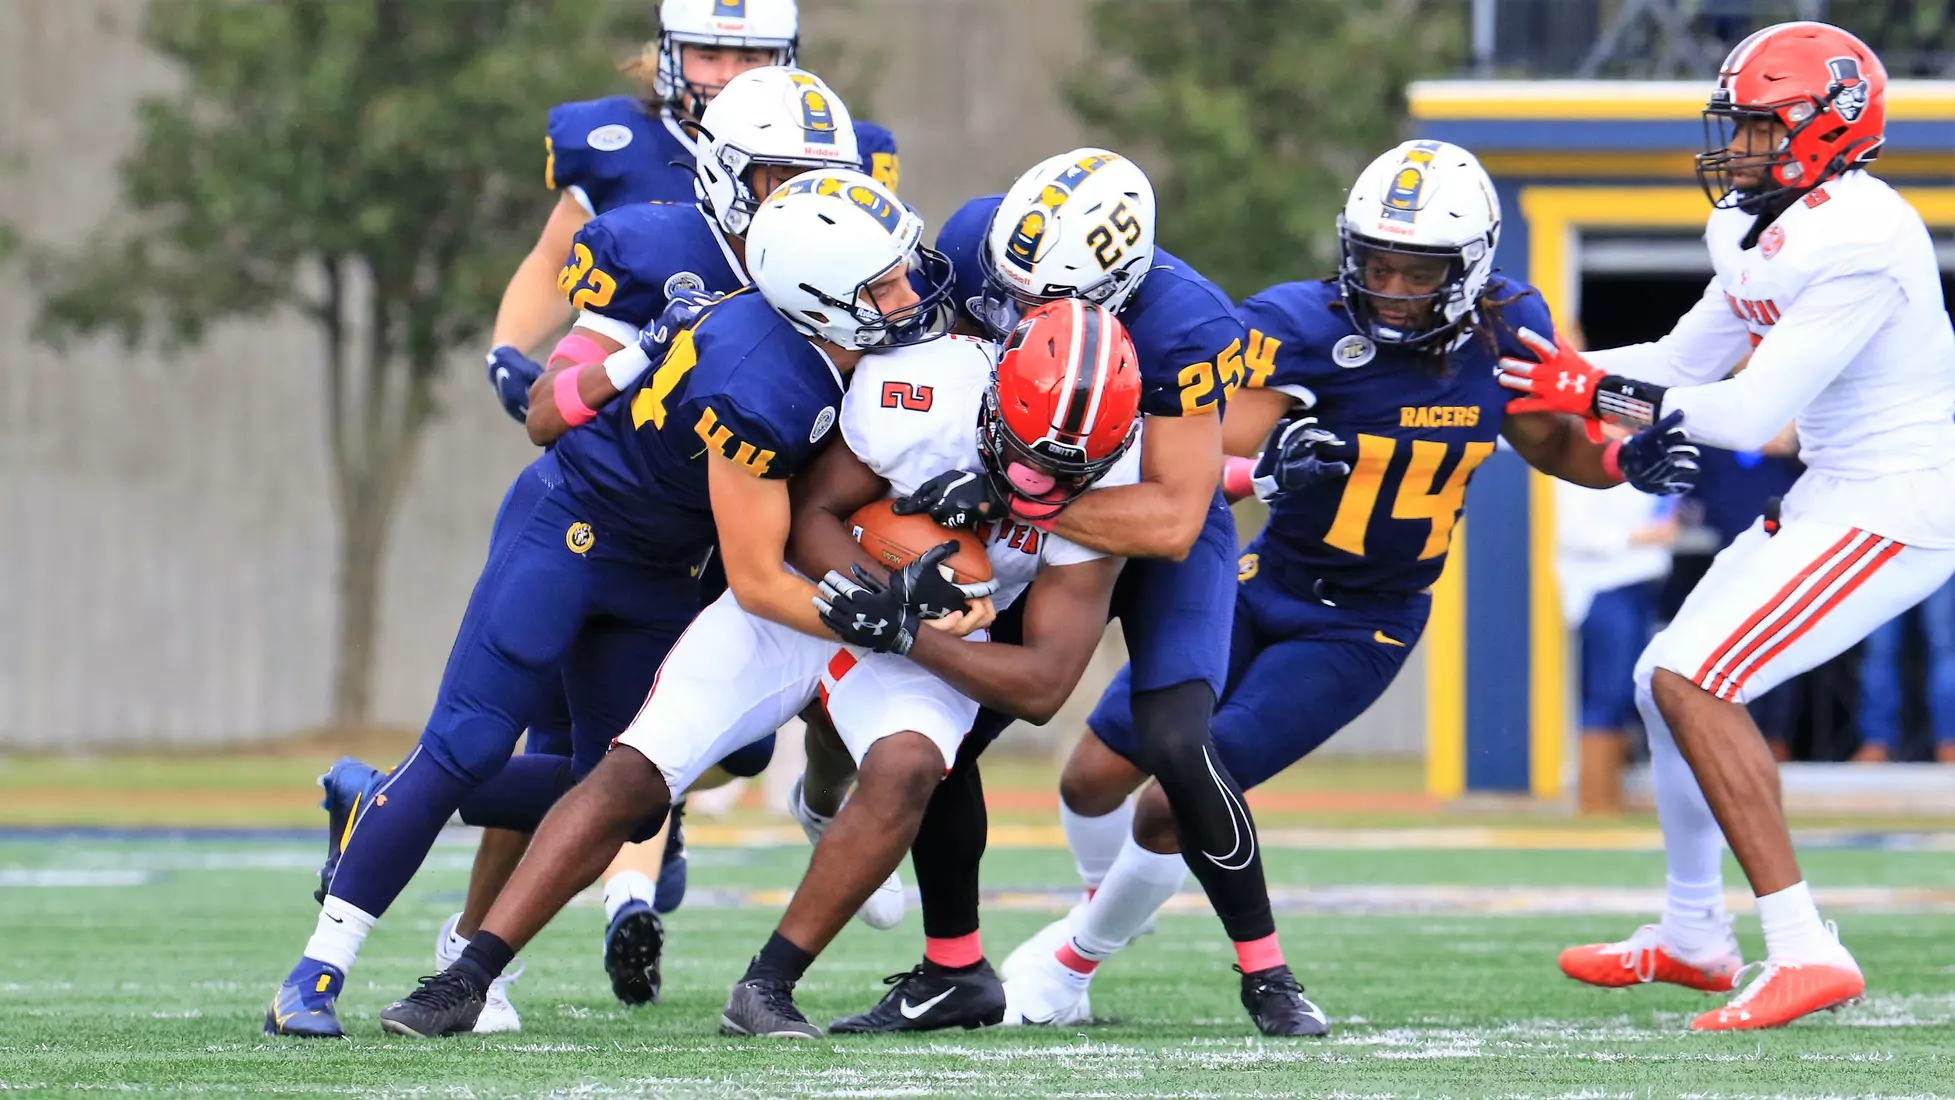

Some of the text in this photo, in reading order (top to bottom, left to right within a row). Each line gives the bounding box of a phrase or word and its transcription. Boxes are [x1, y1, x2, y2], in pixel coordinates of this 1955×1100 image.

[1086, 200, 1142, 271] 25
[558, 243, 617, 309] 32
[881, 380, 933, 412] 2
[1177, 337, 1245, 417] 25
[693, 406, 776, 477] 44
[1401, 405, 1480, 428] RACERS
[1323, 433, 1495, 560] 14
